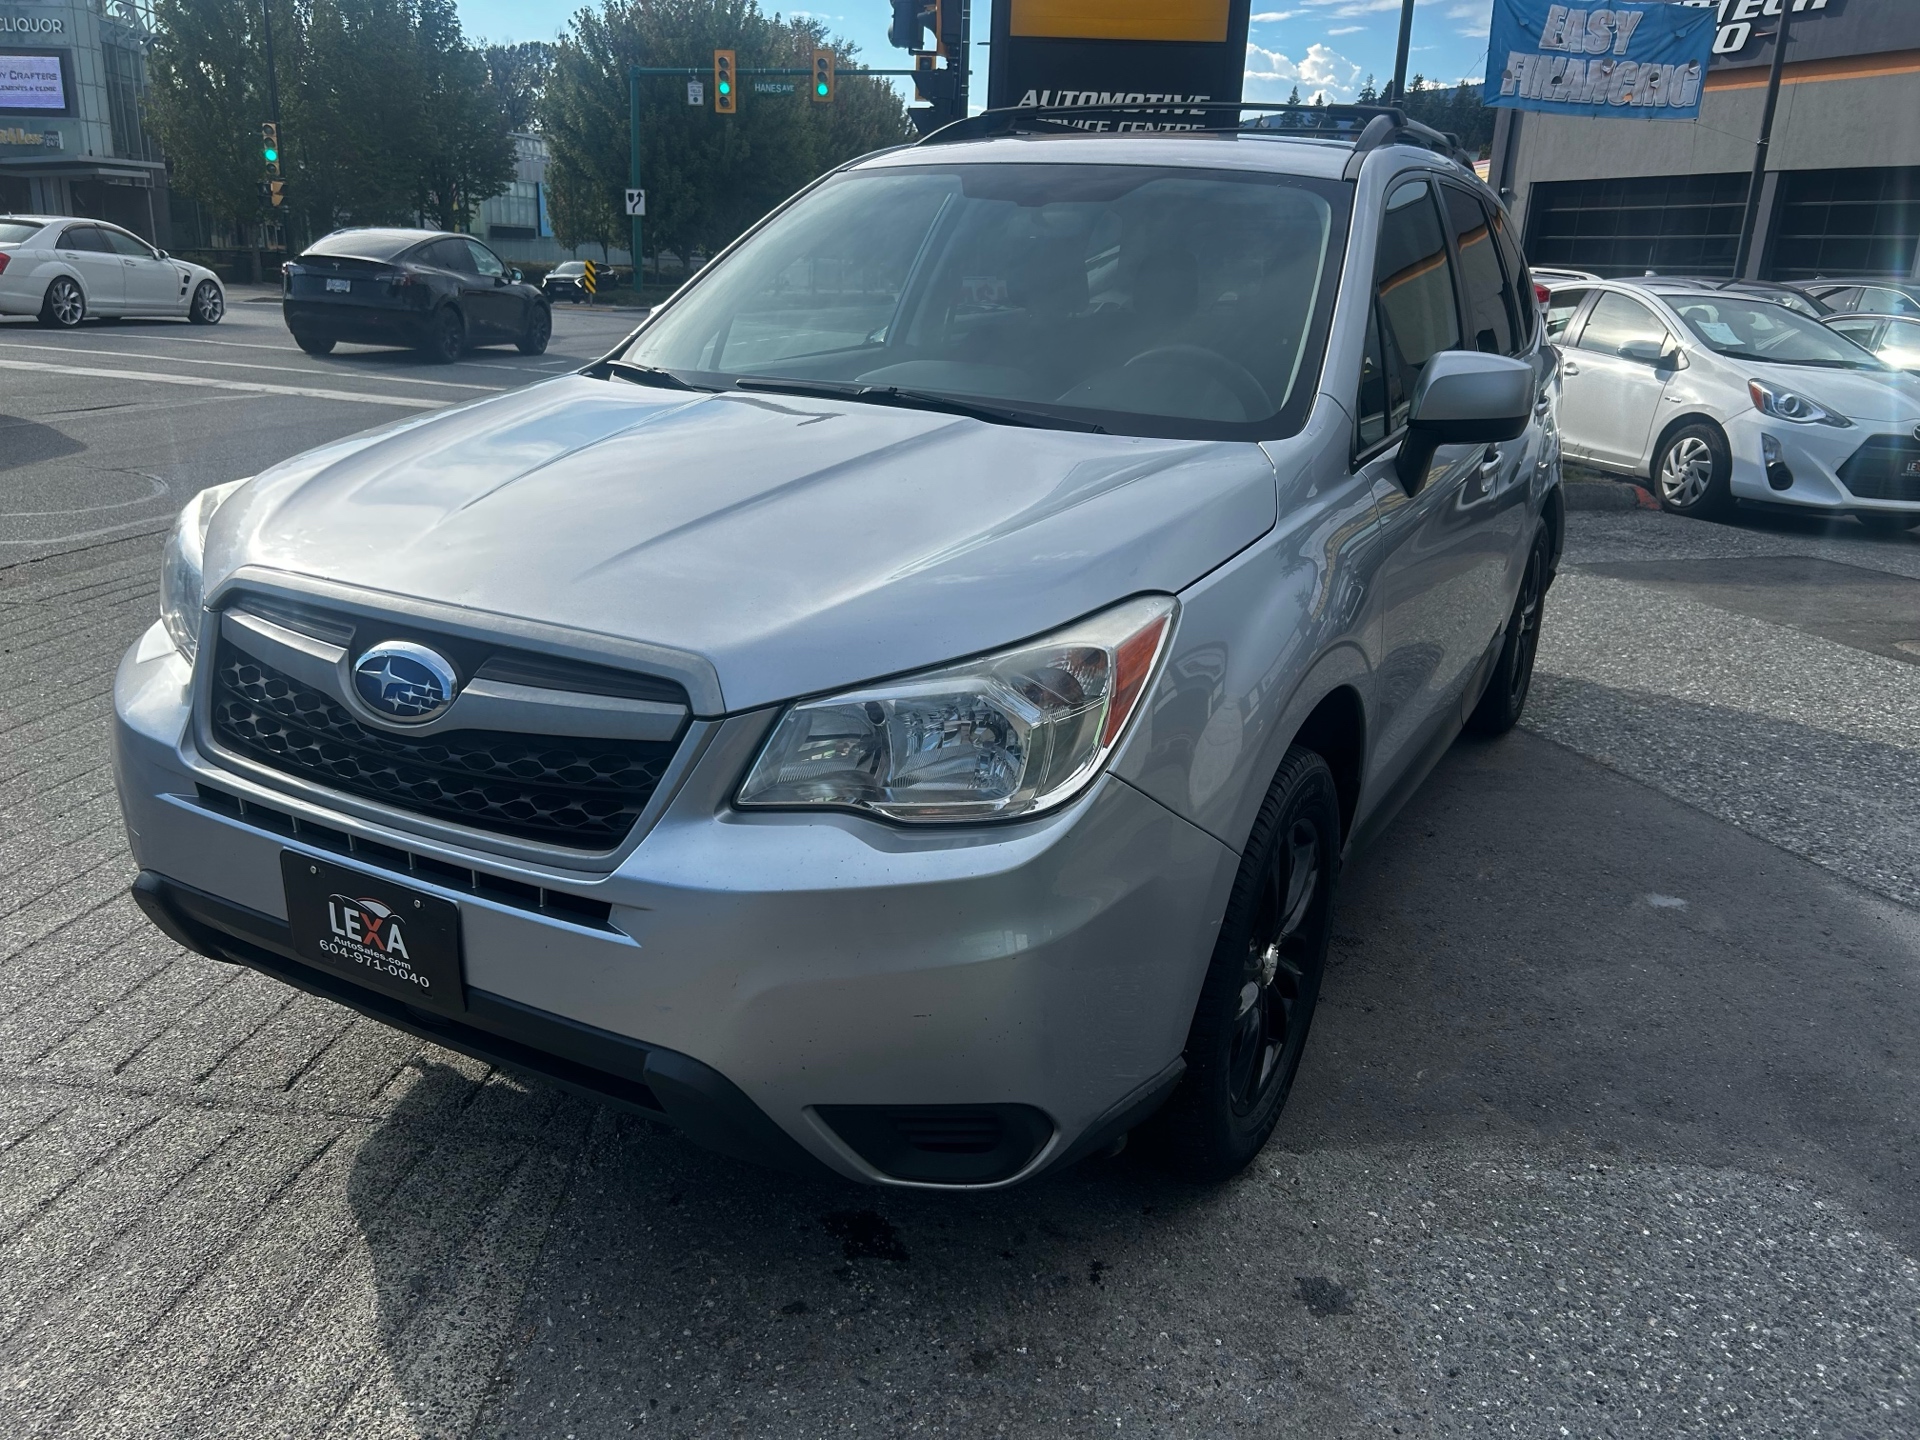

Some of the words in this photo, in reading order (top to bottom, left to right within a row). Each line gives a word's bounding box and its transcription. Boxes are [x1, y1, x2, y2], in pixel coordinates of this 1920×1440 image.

[1539, 4, 1644, 55] EASY
[754, 83, 781, 93] HANES
[1017, 89, 1210, 115] AUTOMOTIVE
[1500, 50, 1701, 108] FINANCING
[329, 901, 409, 960] LEXA
[333, 935, 412, 970] AutoSales.com
[319, 939, 430, 988] 604-971-0040
